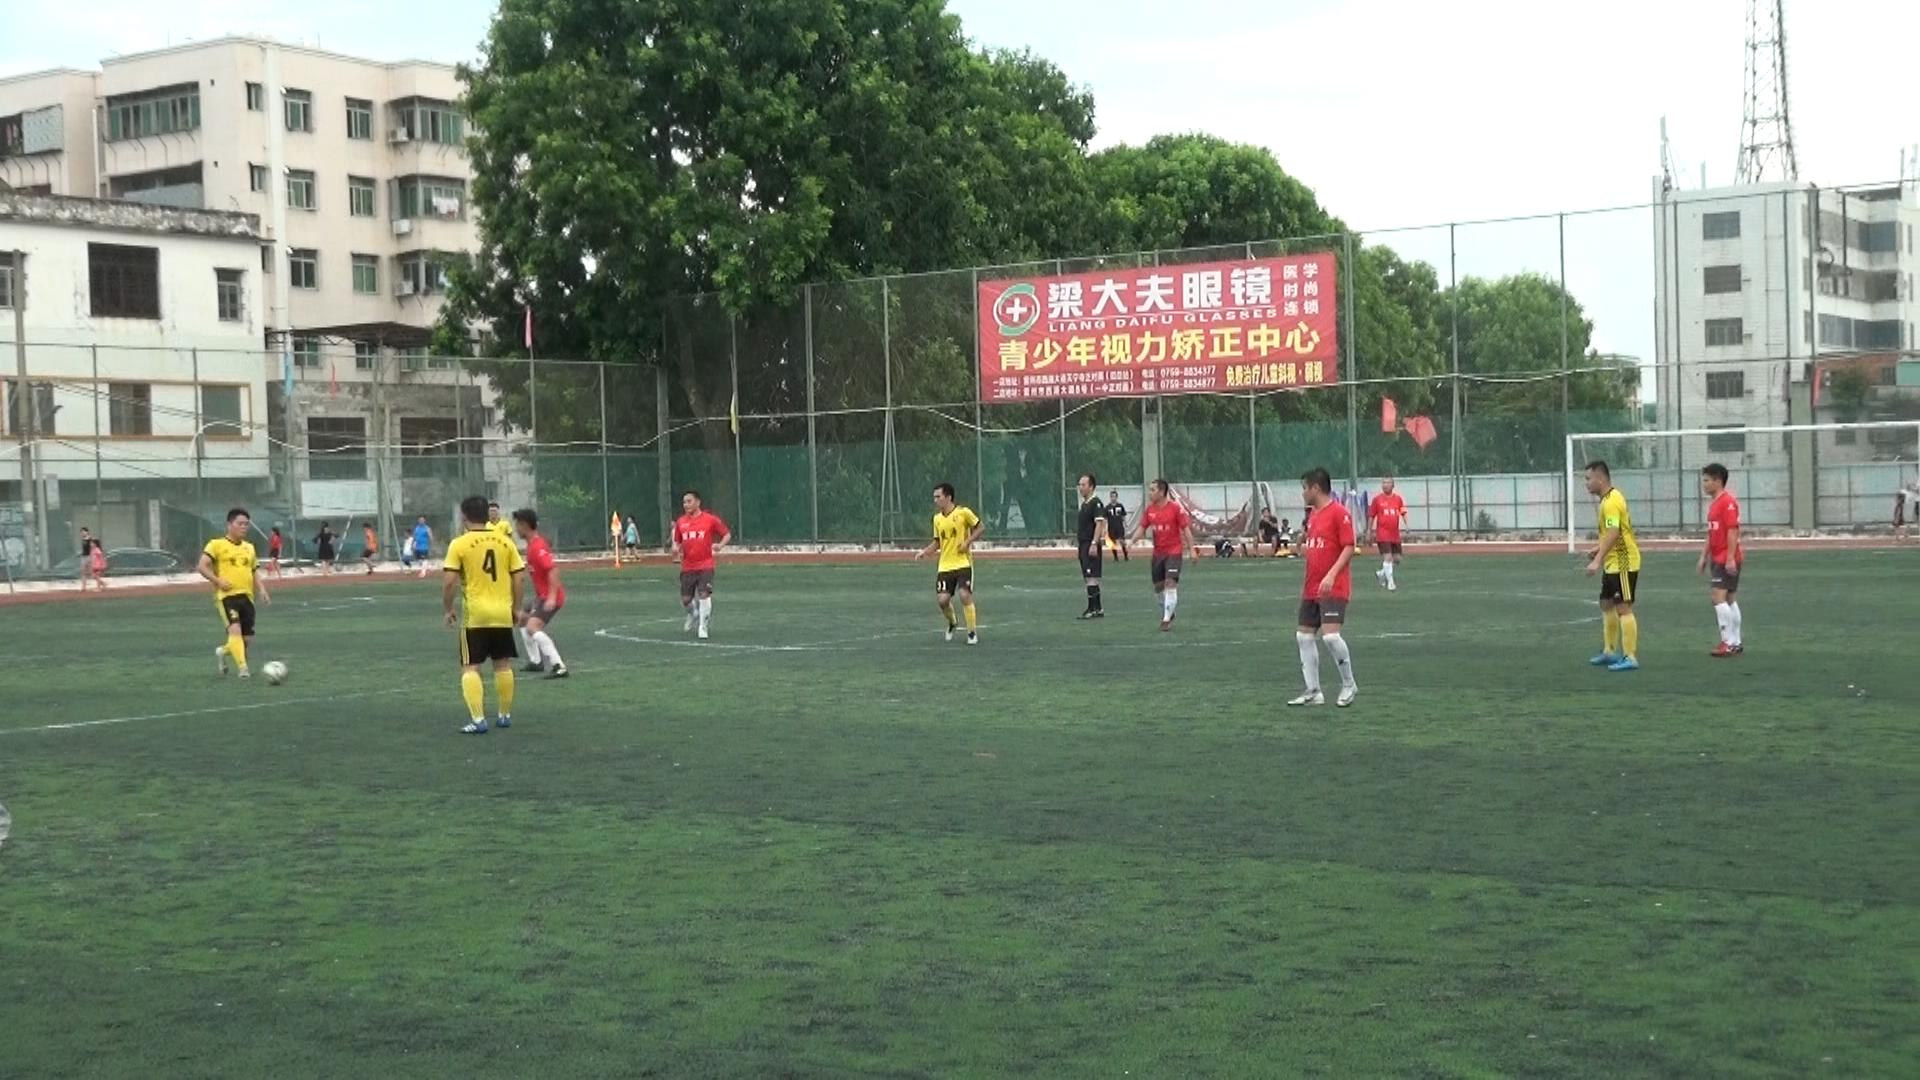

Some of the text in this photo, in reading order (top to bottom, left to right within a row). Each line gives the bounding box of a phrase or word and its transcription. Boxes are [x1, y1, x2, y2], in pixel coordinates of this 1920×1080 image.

[1283, 262, 1318, 280] 医学
[1047, 266, 1272, 318] 梁大夫眼镜
[1283, 281, 1319, 298] 时尚
[1284, 298, 1319, 317] 连锁
[1049, 308, 1278, 333] LIANG DAIFU GLASSES
[997, 320, 1321, 372] 青少年视力矫正中心
[482, 548, 498, 582] 4
